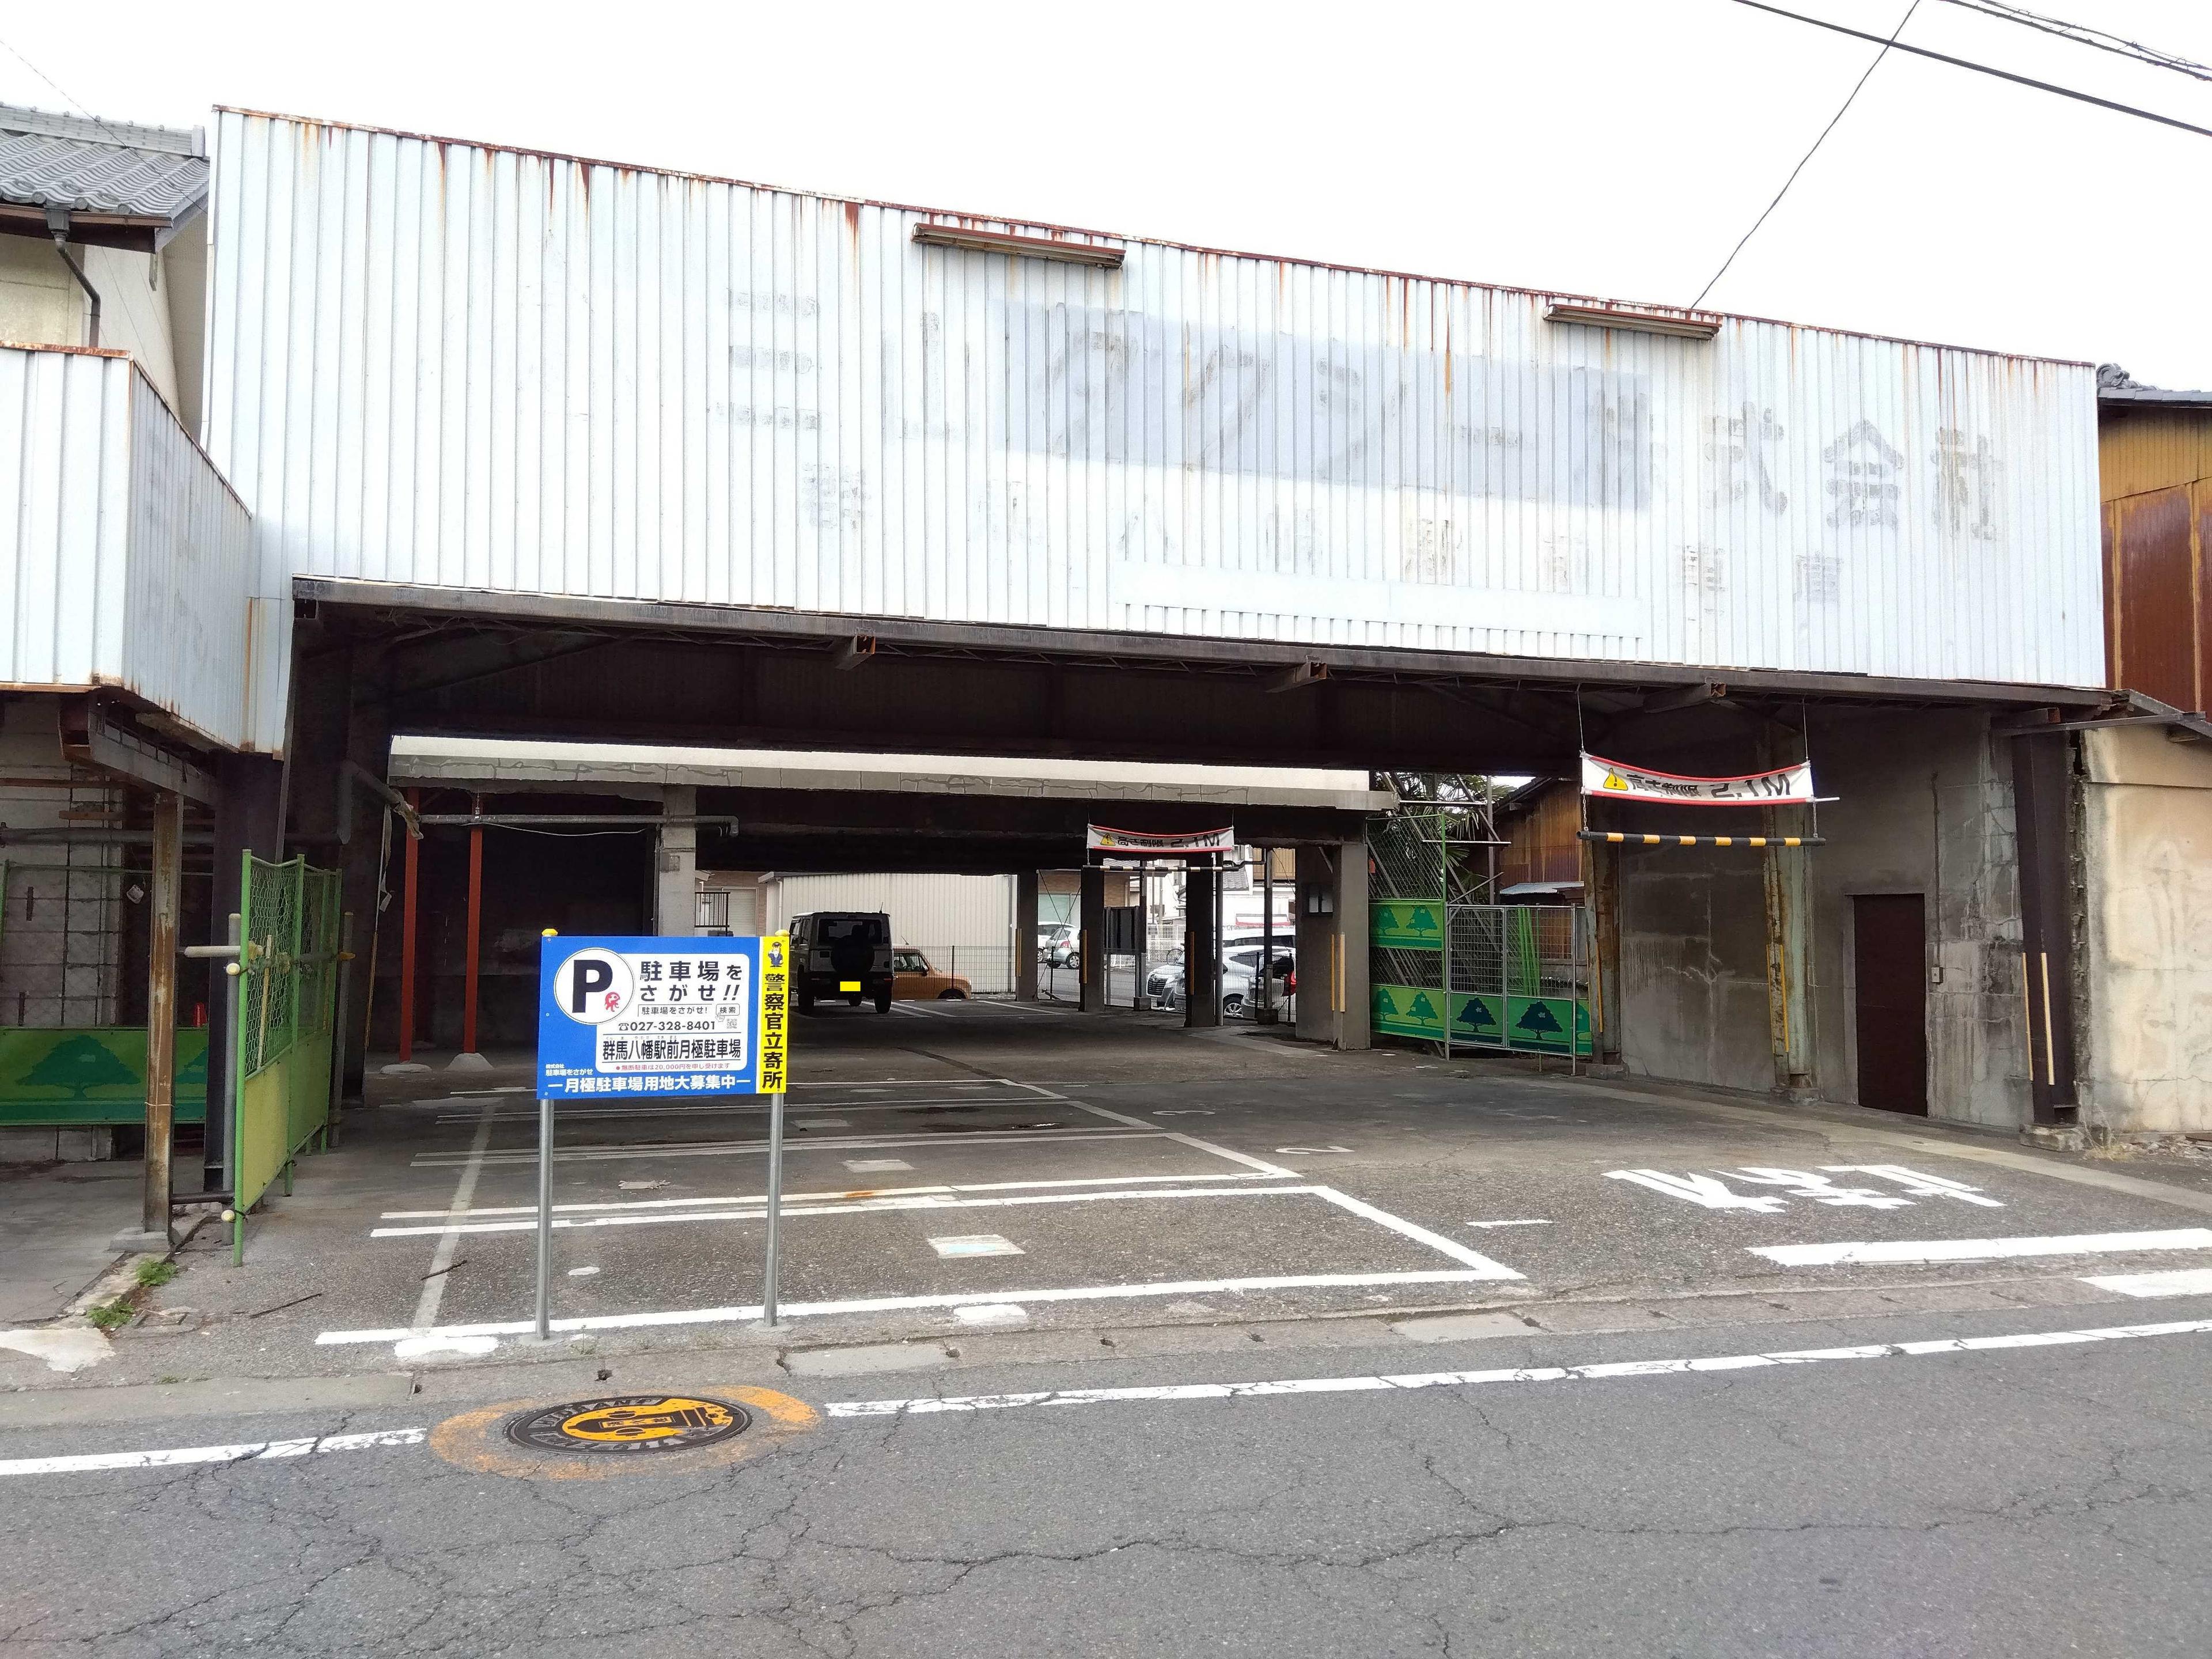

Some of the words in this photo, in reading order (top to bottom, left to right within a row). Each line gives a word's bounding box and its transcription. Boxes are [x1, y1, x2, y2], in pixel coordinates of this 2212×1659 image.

[1710, 773, 1791, 798] 2.1M
[1171, 833, 1219, 848] 2.1M
[639, 961, 742, 981] 駐車場を
[572, 960, 613, 1013] P
[719, 1006, 736, 1014] 検索
[630, 1021, 715, 1031] 027-328-8401
[762, 974, 785, 1089] 警察官立寄所
[603, 1039, 741, 1060] 群馬八幡駅前月極駐車場
